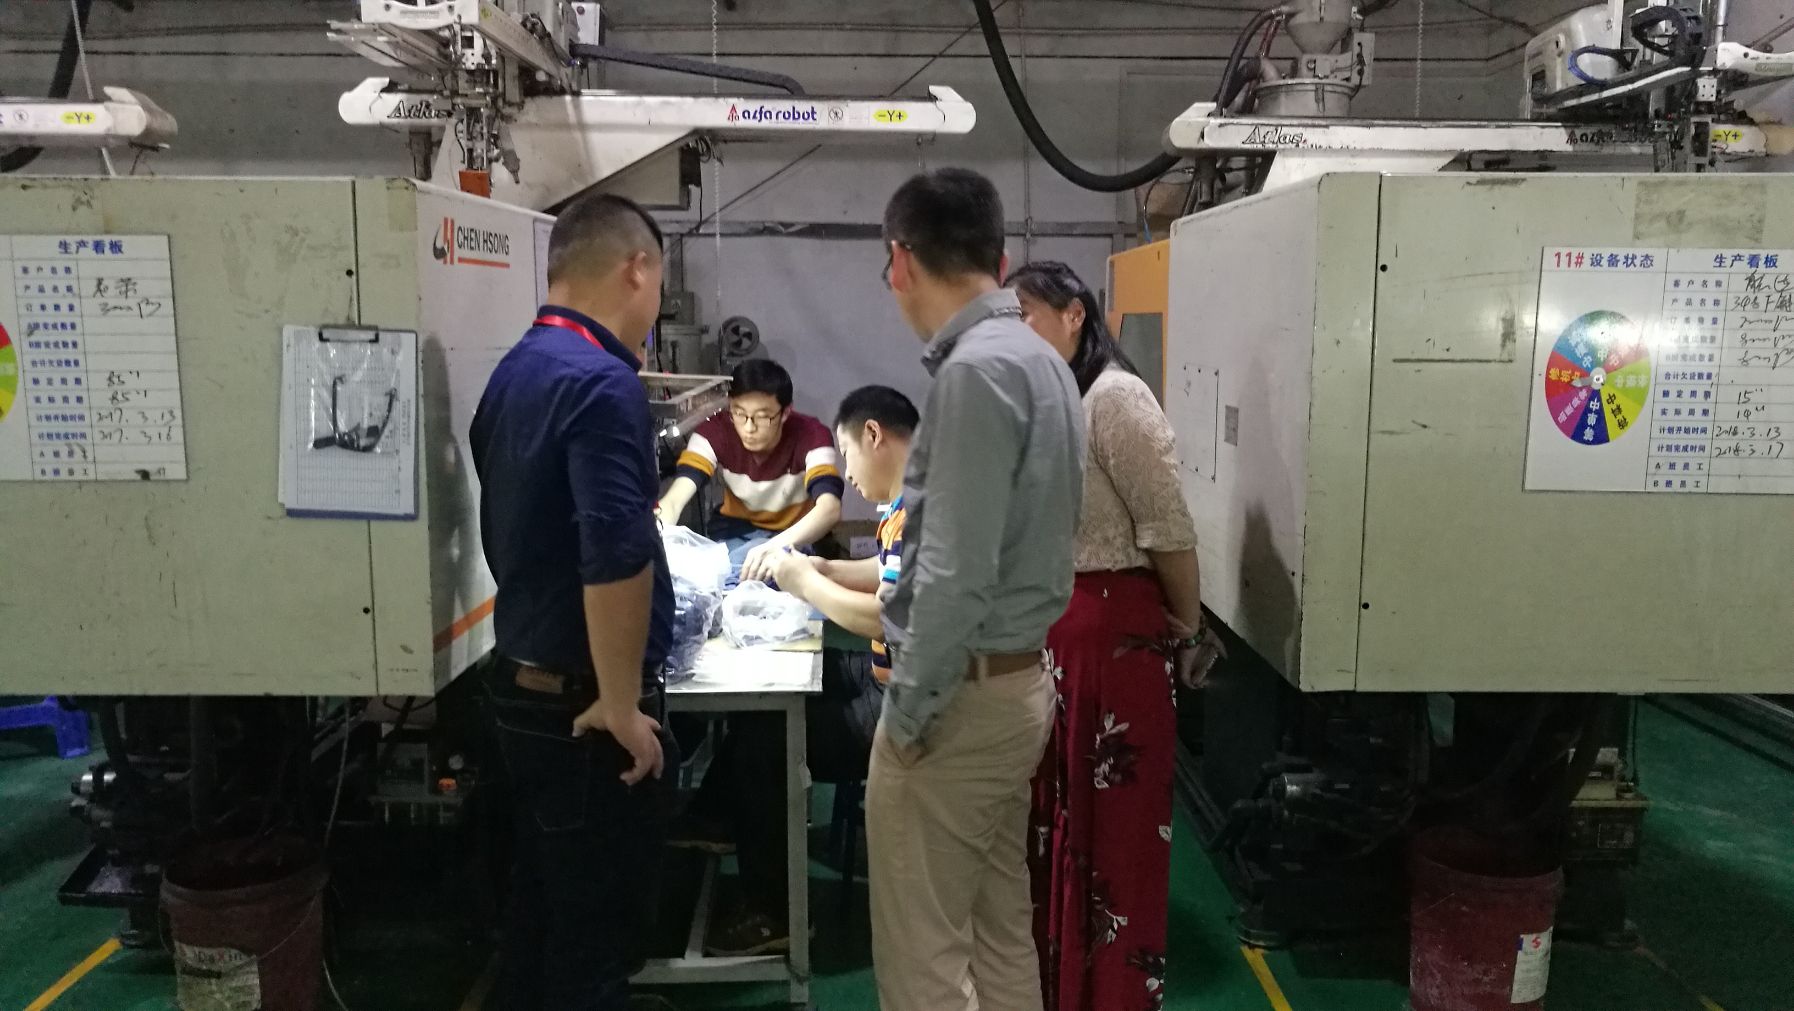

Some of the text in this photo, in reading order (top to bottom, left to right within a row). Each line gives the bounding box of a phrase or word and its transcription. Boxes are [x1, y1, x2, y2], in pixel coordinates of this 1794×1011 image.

[776, 105, 817, 121] robot
[58, 239, 124, 254] 生产看板
[457, 226, 510, 256] CHEN HSONG
[1554, 251, 1654, 269] 11# 设备状态
[1713, 253, 1778, 269] 生产看板
